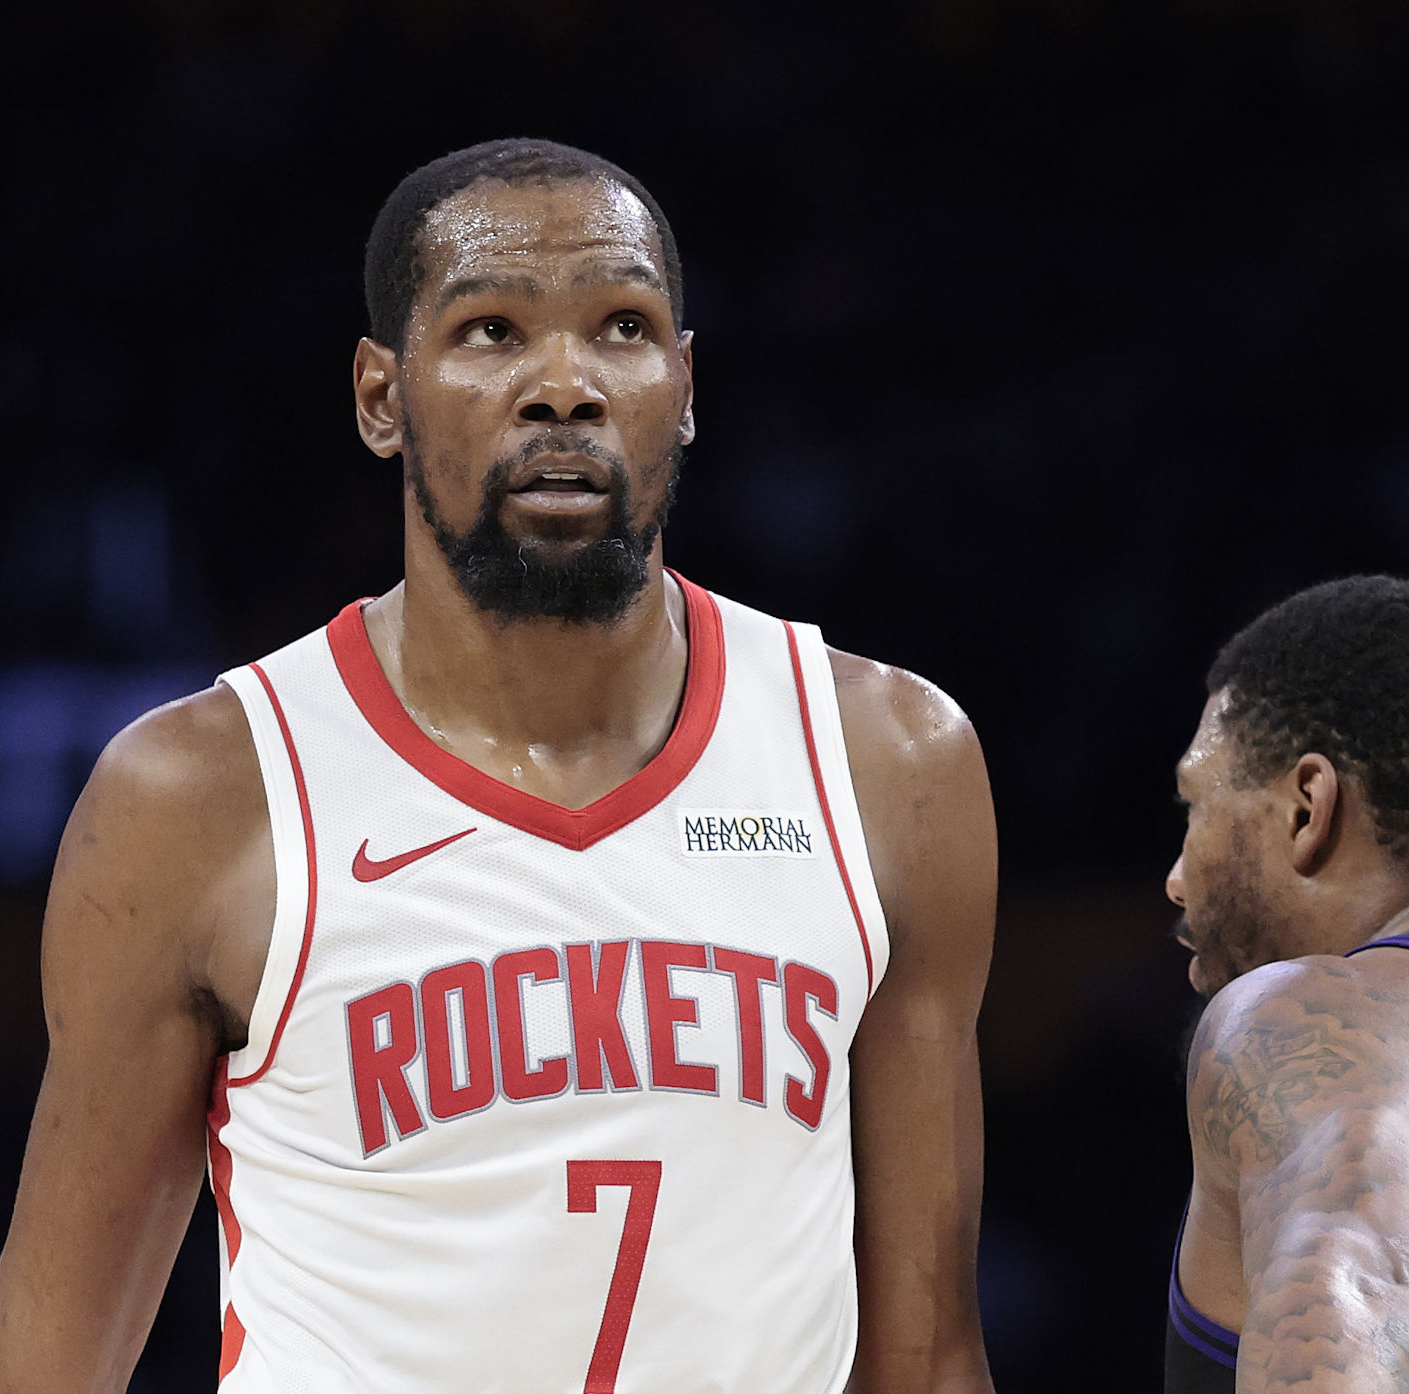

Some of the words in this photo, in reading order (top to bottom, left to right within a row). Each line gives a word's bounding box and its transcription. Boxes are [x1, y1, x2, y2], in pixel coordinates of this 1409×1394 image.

[685, 816, 811, 837] MEMORIAL
[687, 834, 812, 854] HERMANN
[344, 936, 839, 1160] ROCKETS
[566, 1160, 662, 1394] 7
